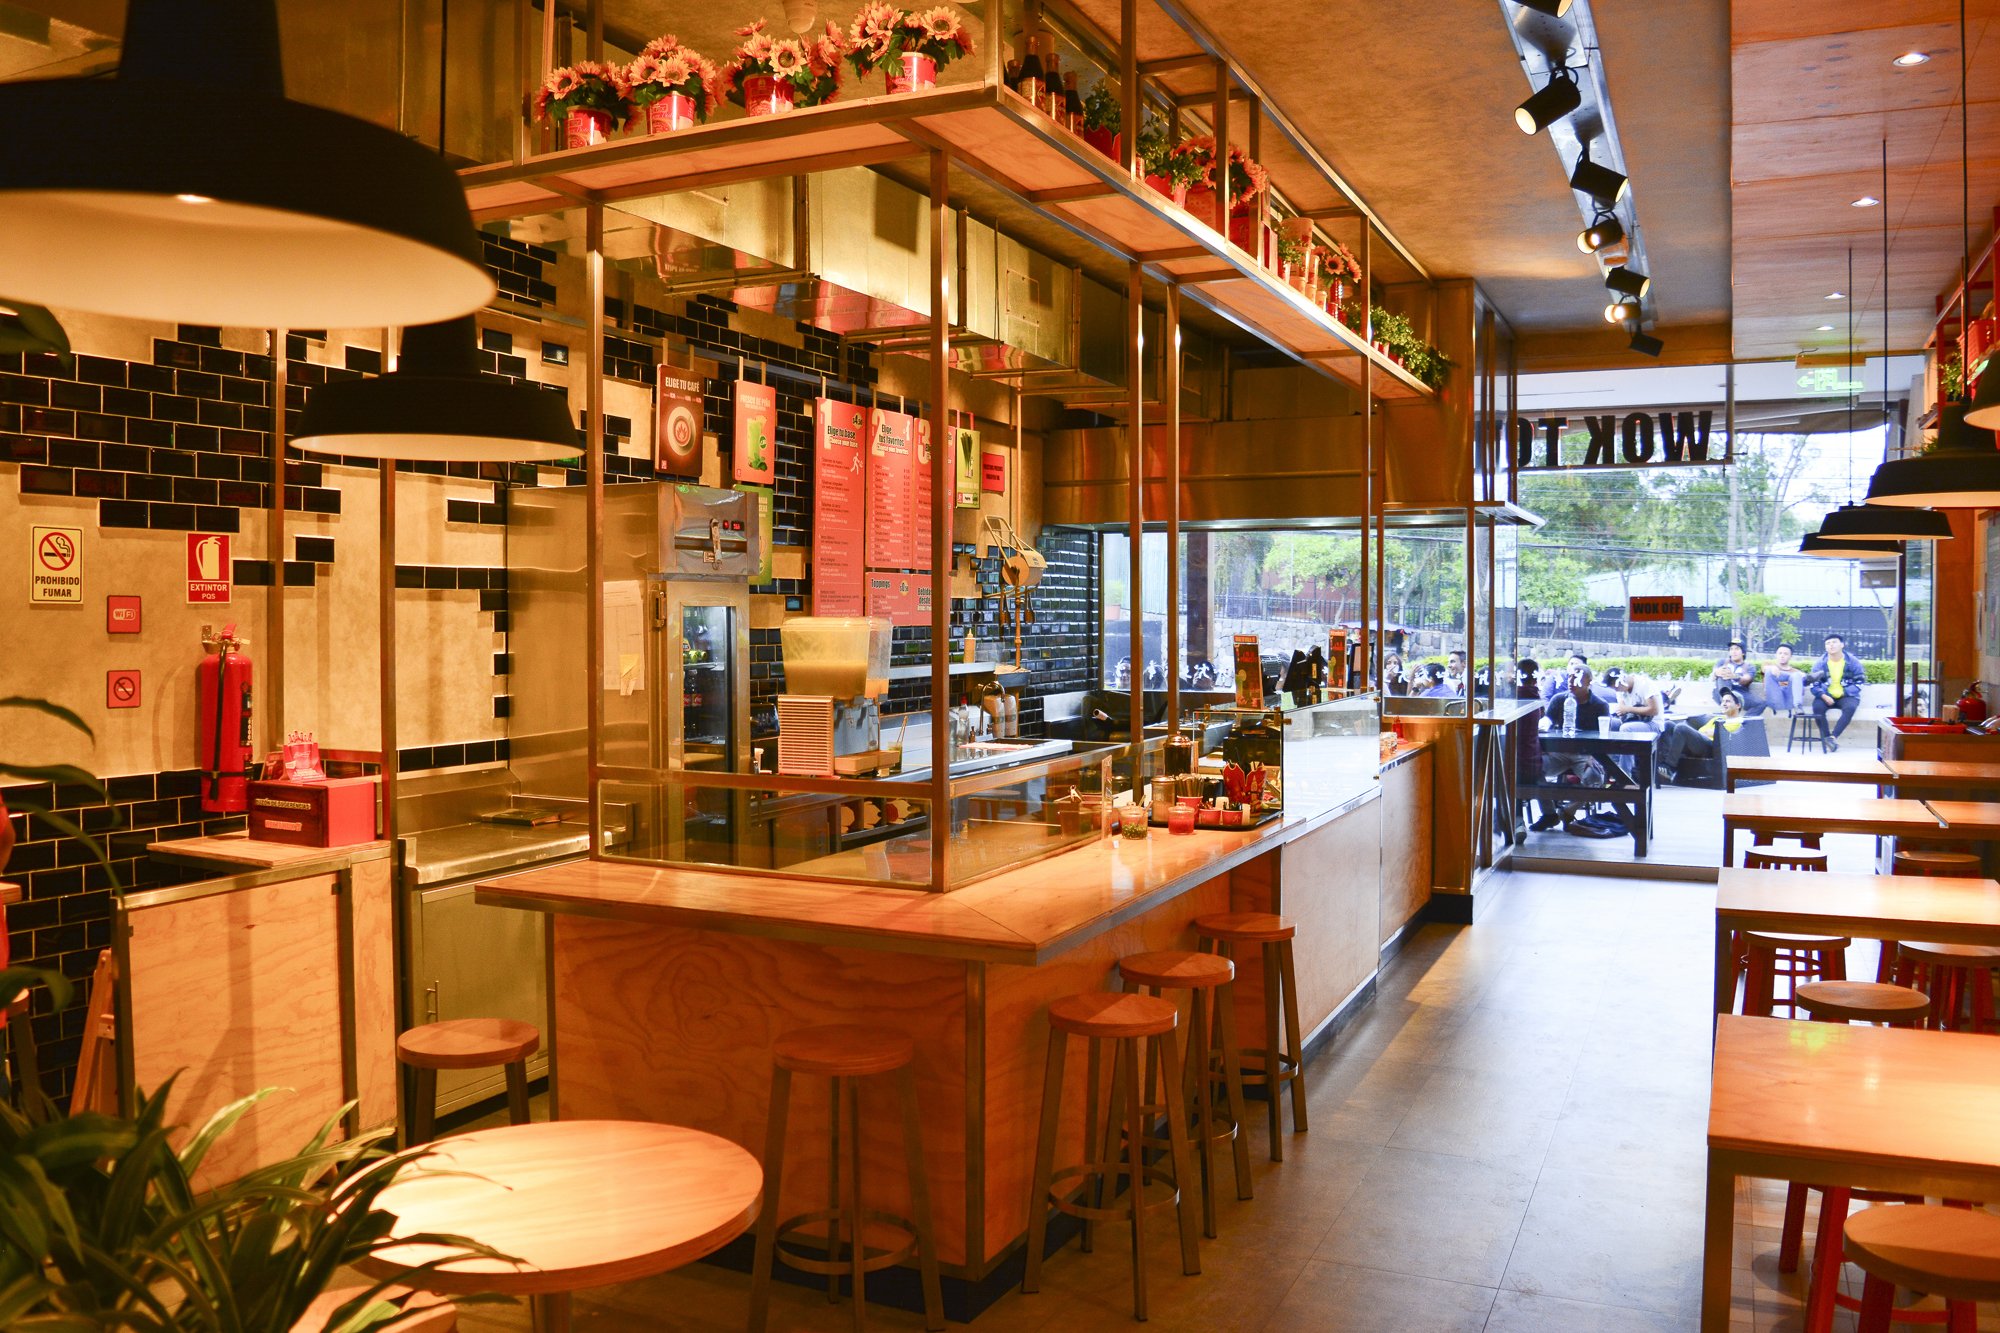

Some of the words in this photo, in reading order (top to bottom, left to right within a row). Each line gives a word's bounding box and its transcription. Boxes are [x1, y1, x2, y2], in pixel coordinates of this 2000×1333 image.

[665, 376, 680, 389] ELIGE
[680, 379, 687, 391] TU
[687, 381, 700, 393] CAFÉ
[820, 399, 832, 449] 1
[881, 424, 892, 434] Elige
[828, 425, 838, 436] Elige
[838, 428, 845, 437] tu
[845, 429, 856, 439] base
[872, 408, 885, 457] 2
[886, 436, 905, 446] favoritos
[35, 576, 80, 585] PROHIBIDO
[871, 578, 891, 589] Toppings
[190, 583, 228, 591] EXTINTOR
[917, 587, 932, 595] Bebida
[43, 588, 72, 597] FUMAR
[1633, 603, 1659, 614] WOK
[1662, 602, 1681, 614] OFF
